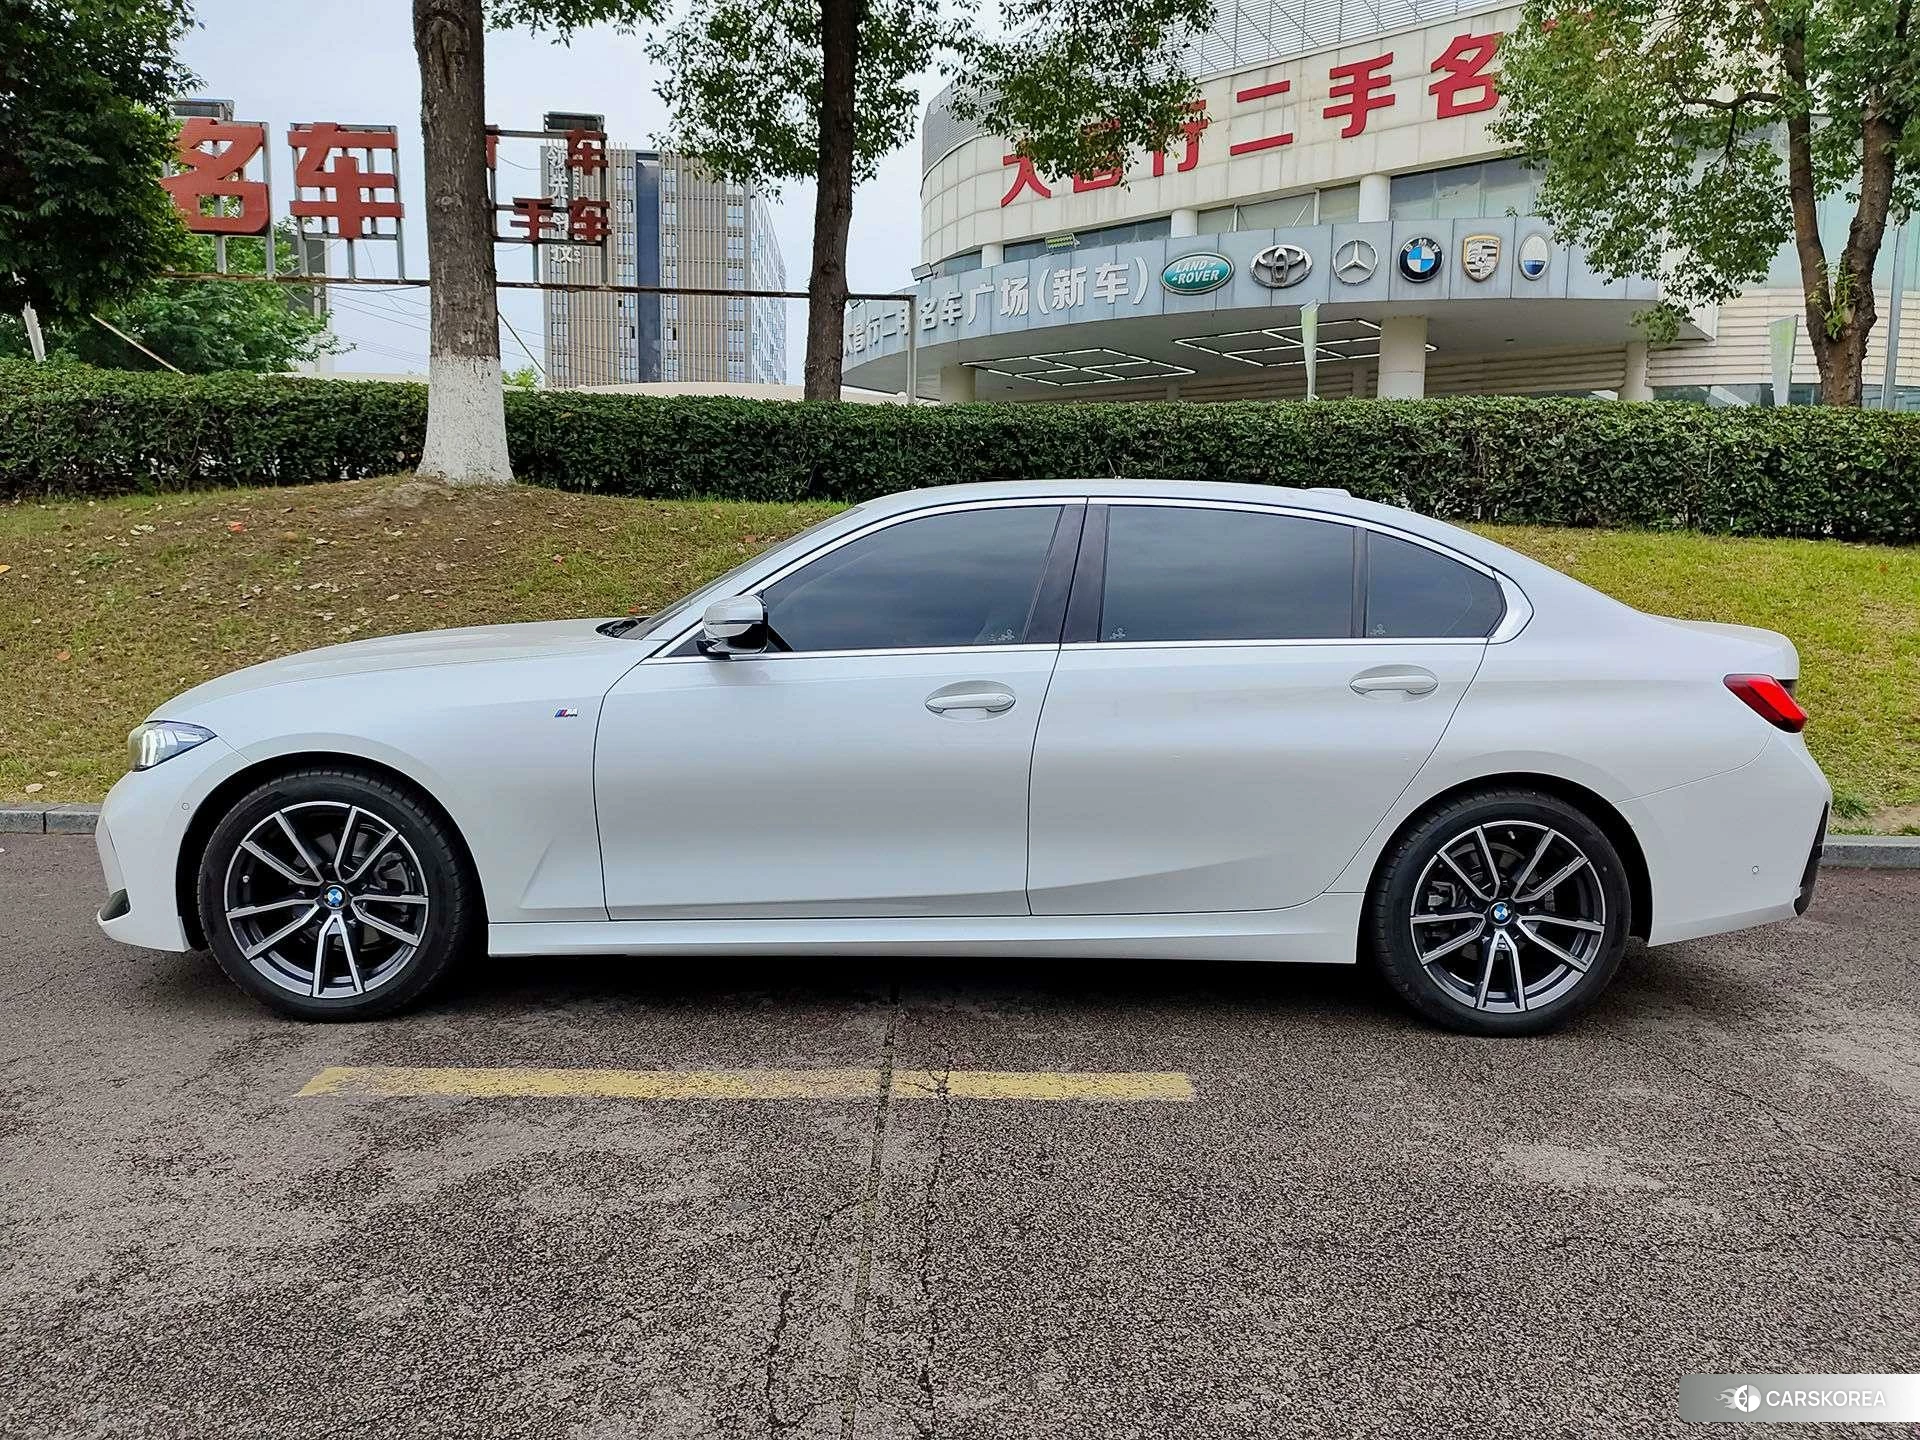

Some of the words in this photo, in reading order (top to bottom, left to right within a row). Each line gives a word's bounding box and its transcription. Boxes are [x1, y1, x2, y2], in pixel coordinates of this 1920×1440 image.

[1404, 238, 1441, 253] BMW
[1175, 260, 1208, 273] LAND
[1178, 269, 1220, 284] ROVER
